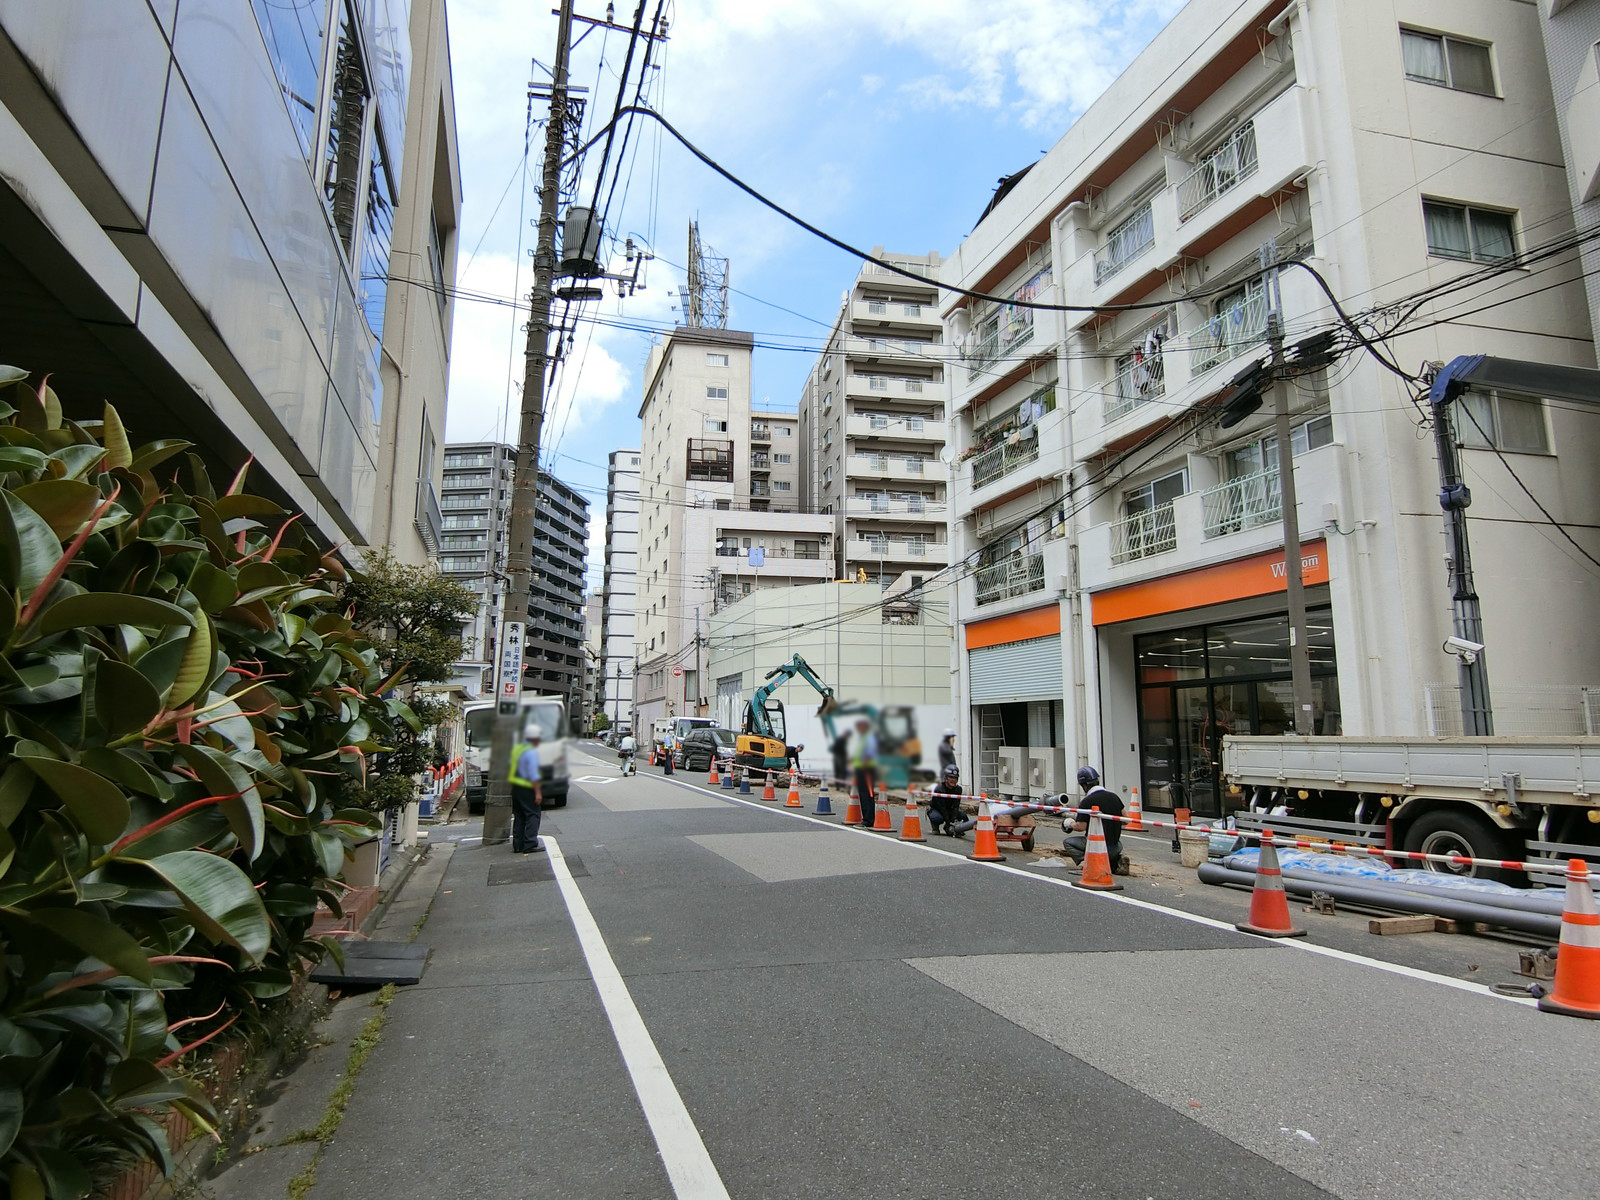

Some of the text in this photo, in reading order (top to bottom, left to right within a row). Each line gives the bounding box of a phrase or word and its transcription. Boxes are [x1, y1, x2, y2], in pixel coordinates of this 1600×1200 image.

[509, 623, 520, 645] 秀林
[511, 647, 520, 682] 日本語学校
